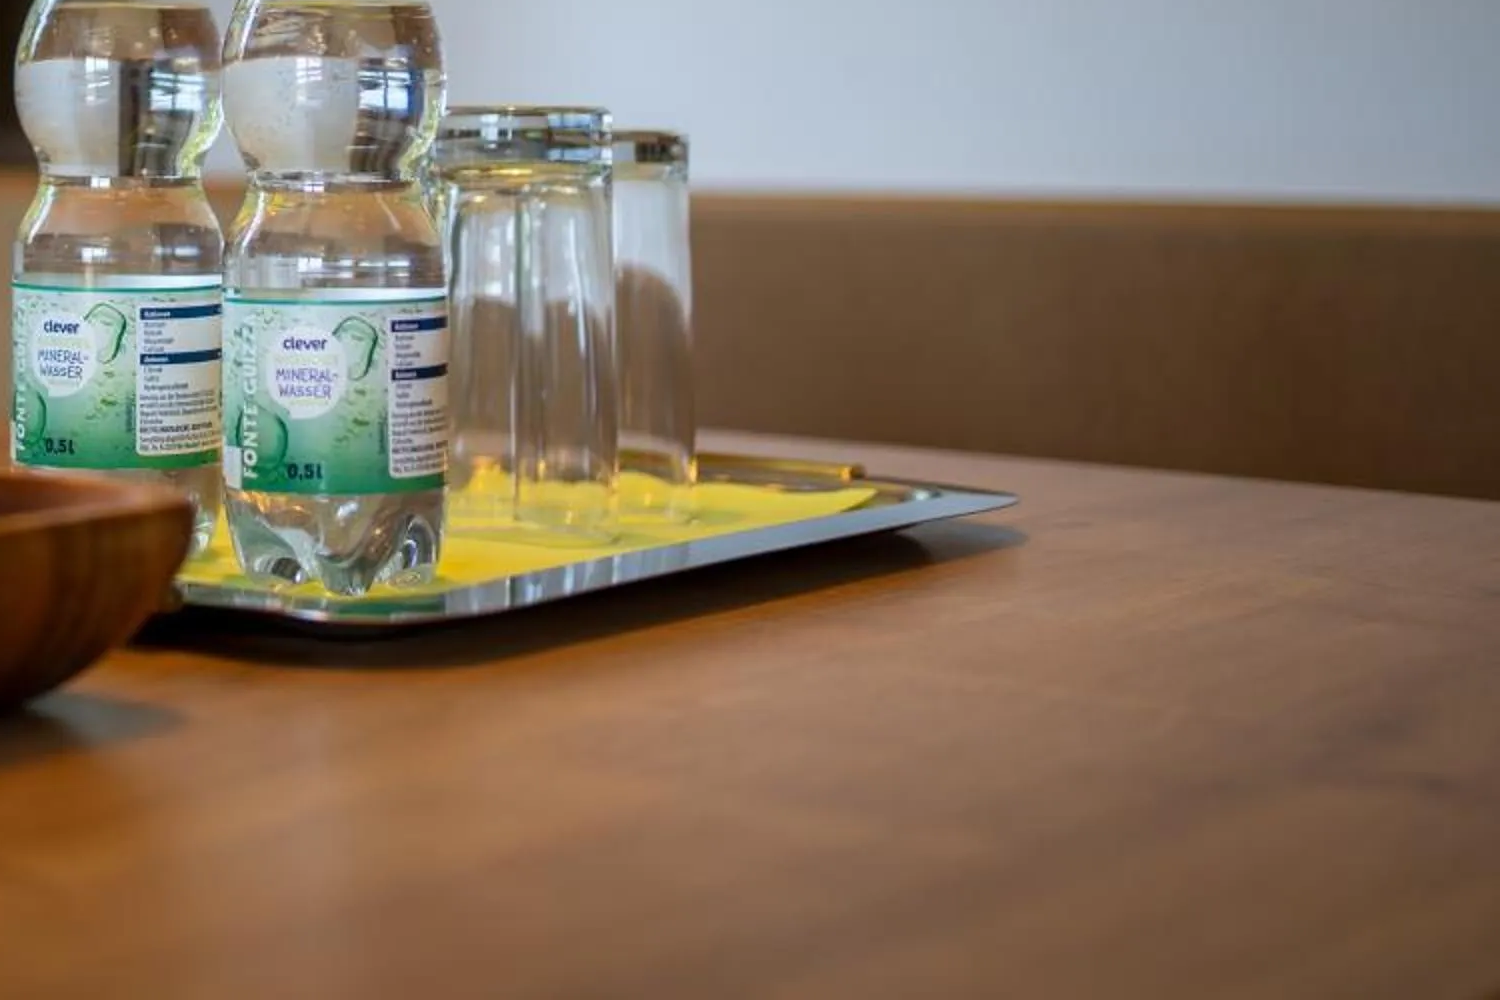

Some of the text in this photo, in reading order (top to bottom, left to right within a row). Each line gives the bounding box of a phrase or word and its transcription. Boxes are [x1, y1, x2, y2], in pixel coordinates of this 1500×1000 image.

[43, 319, 80, 334] clever
[283, 336, 328, 352] clever
[40, 364, 83, 380] WASSER
[276, 367, 338, 383] MINERAL-
[279, 384, 332, 400] WASSER
[243, 401, 258, 479] FONTE
